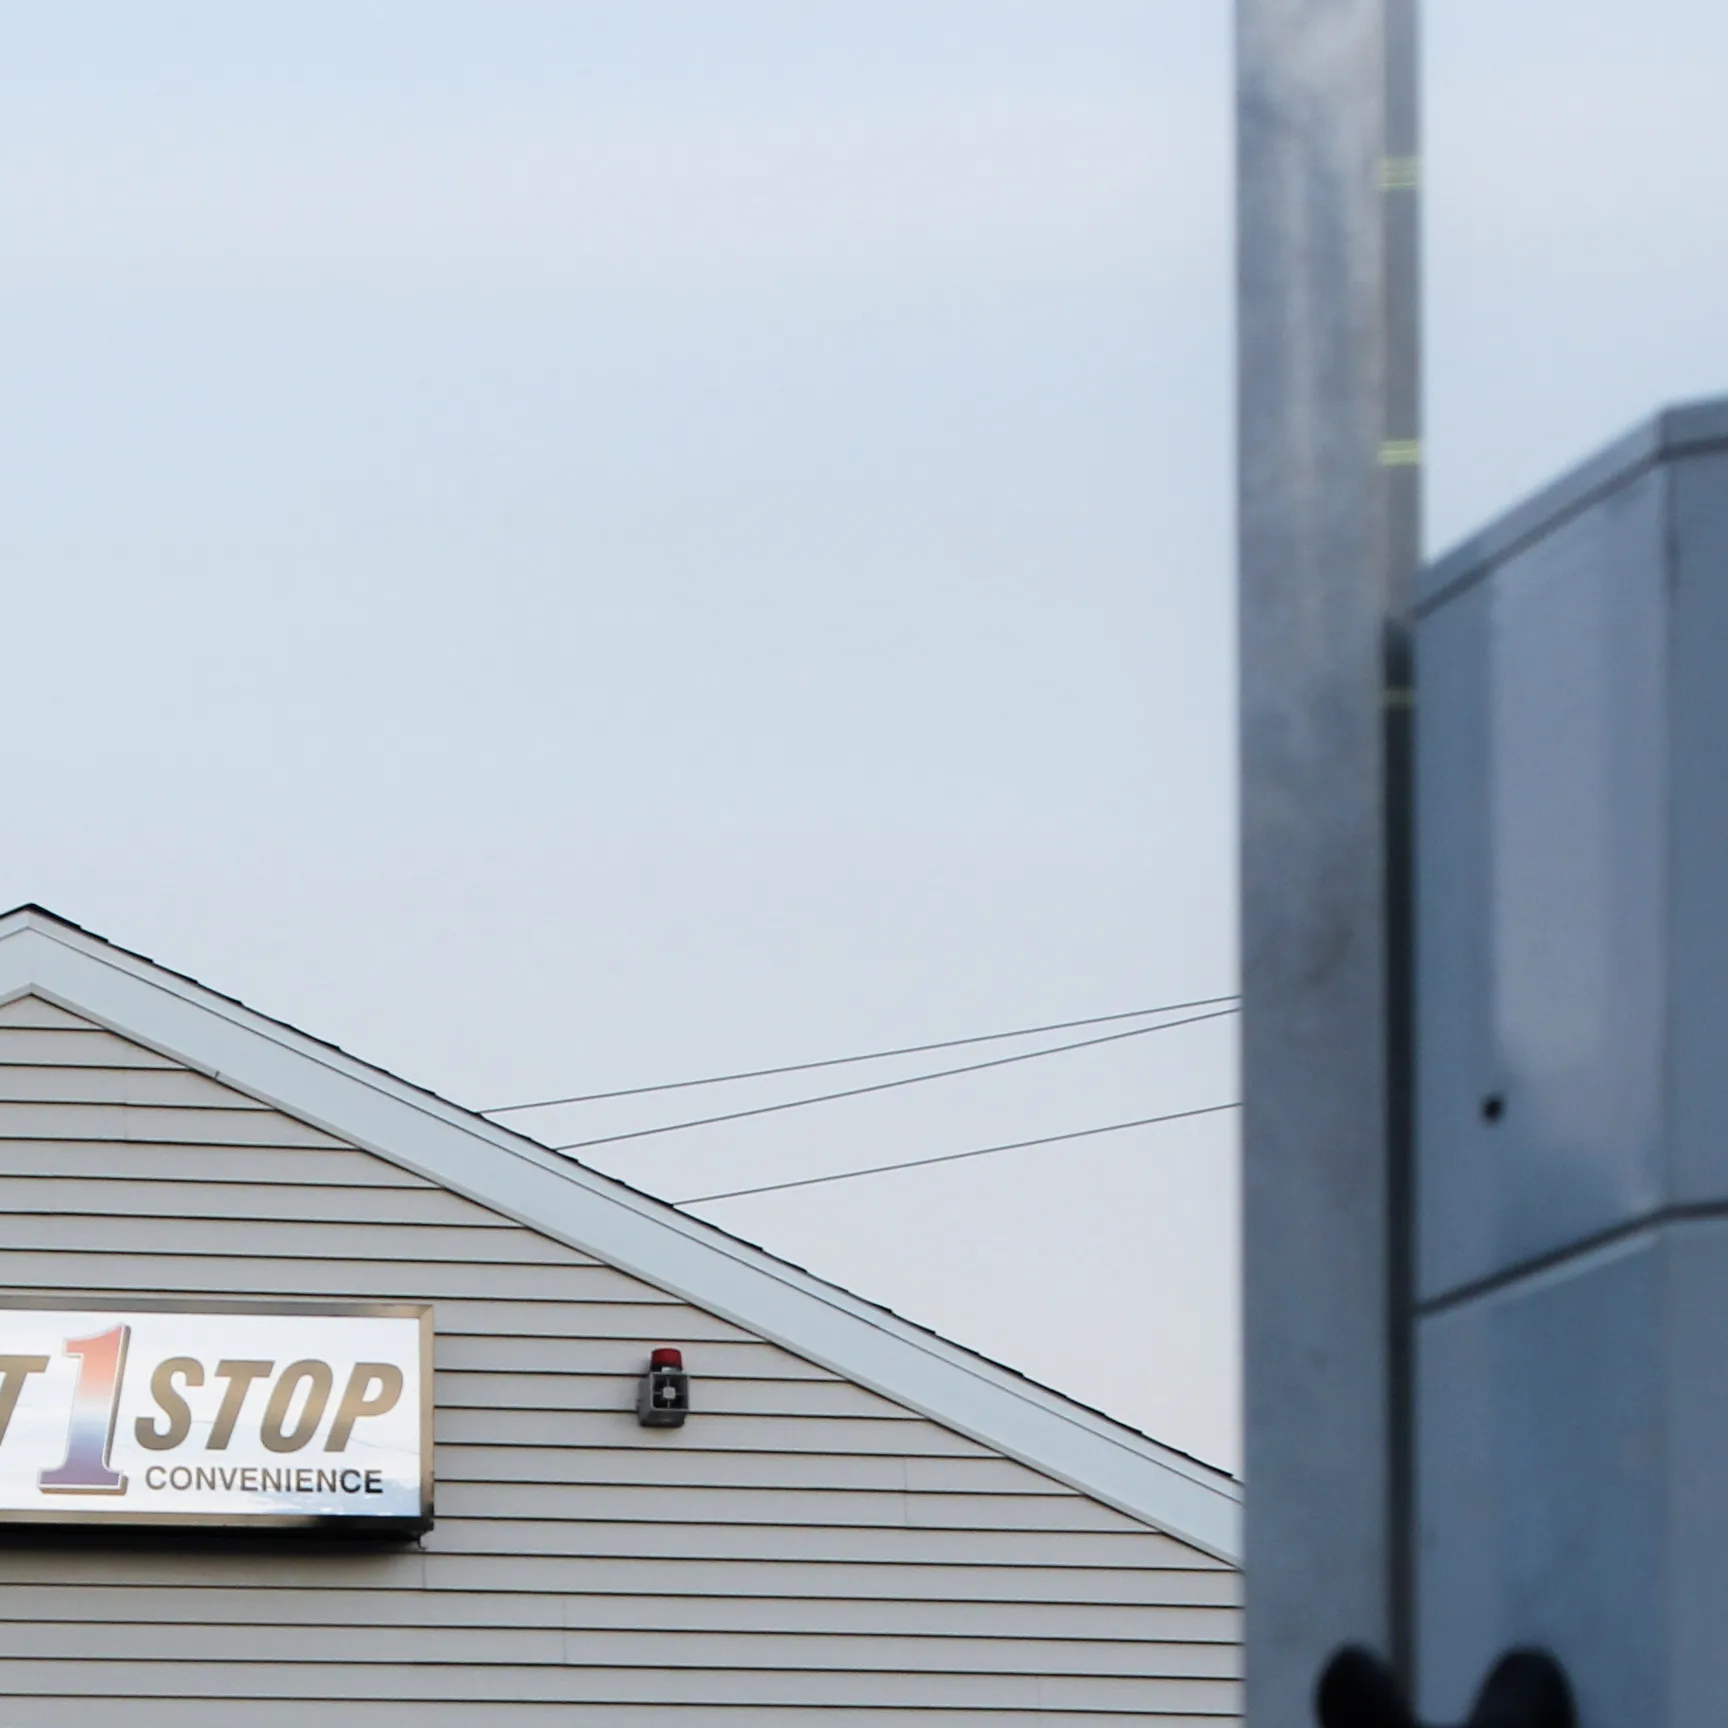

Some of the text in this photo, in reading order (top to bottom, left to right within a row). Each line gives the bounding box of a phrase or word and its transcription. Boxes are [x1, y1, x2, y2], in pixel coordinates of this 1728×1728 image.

[37, 1322, 130, 1495] 1
[133, 1355, 404, 1453] STOP
[144, 1463, 384, 1495] CONVENIENCE
